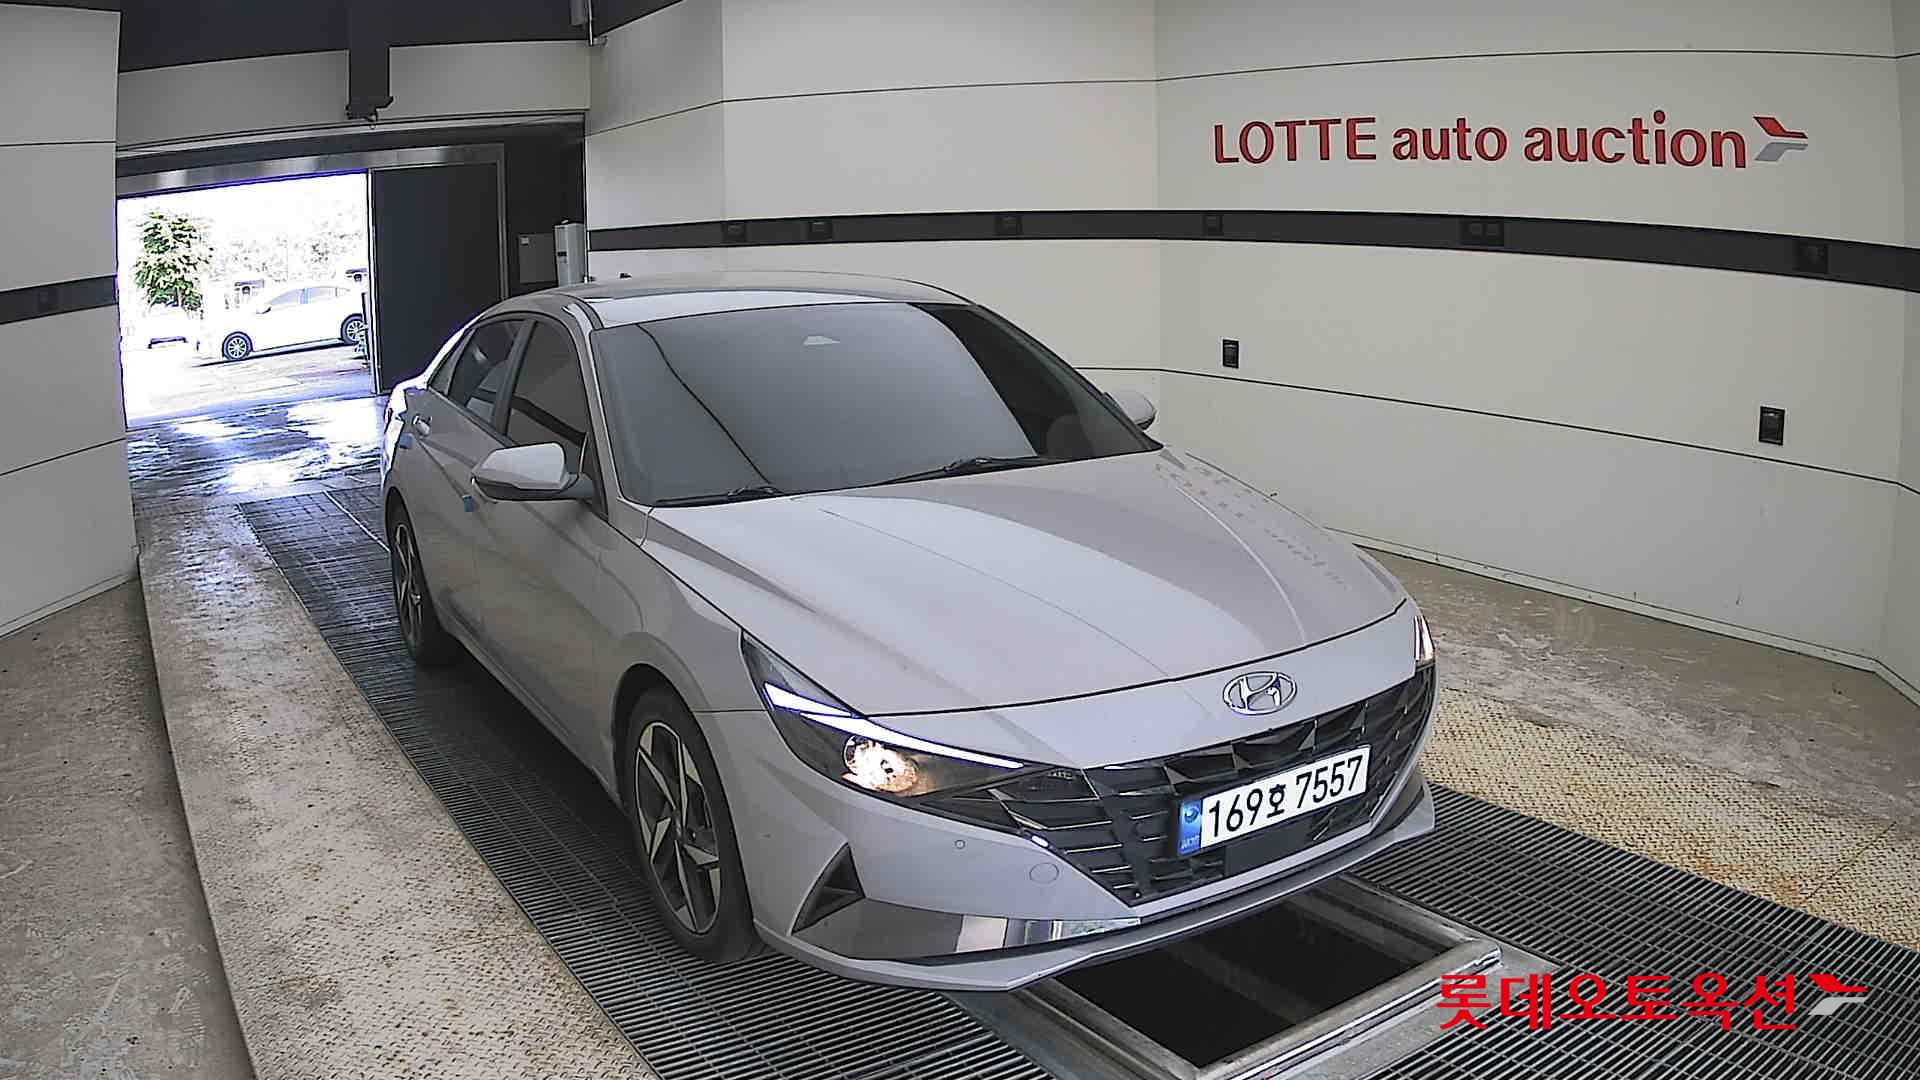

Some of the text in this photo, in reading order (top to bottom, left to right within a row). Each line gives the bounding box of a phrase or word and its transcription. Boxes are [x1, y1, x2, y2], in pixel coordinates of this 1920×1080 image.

[1213, 109, 1747, 168] LOTTE auto auction
[1208, 755, 1364, 838] 169호 7557
